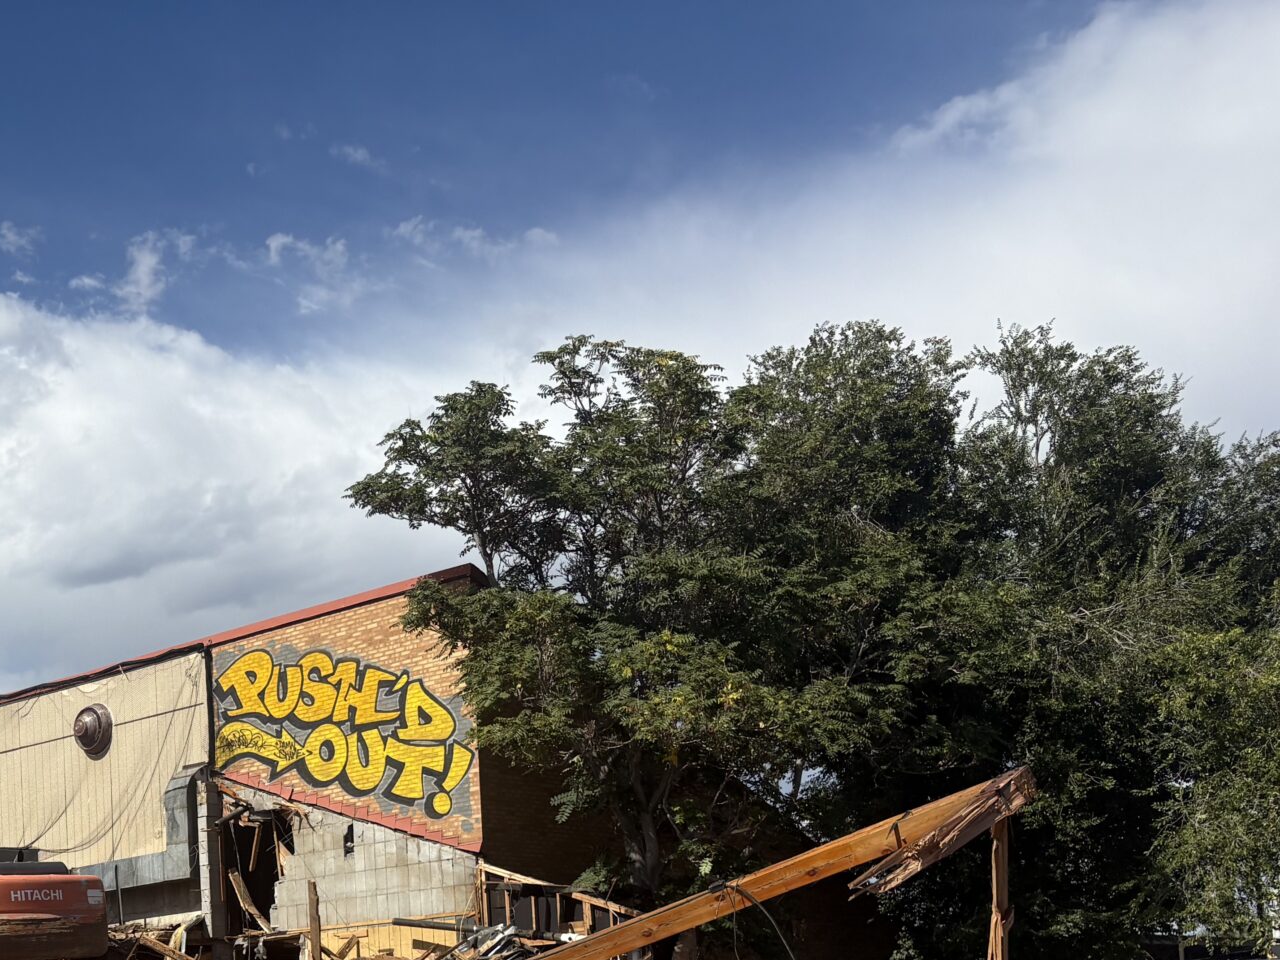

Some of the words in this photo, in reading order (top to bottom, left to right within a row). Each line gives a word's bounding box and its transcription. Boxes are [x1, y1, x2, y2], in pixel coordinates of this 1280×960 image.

[215, 648, 457, 742] PUSH'D
[304, 722, 474, 816] OUT!
[10, 889, 63, 902] HITACHI
